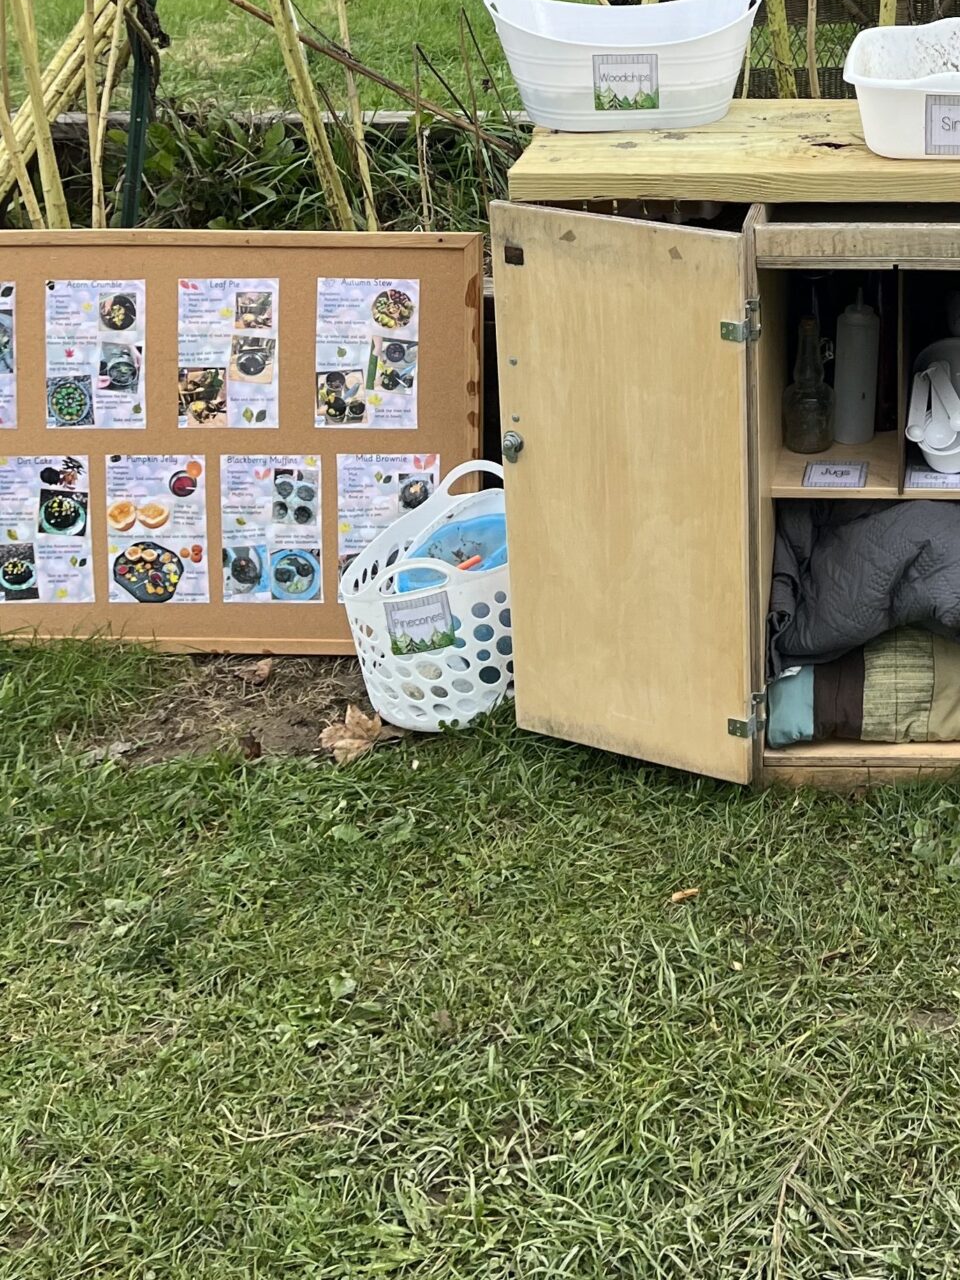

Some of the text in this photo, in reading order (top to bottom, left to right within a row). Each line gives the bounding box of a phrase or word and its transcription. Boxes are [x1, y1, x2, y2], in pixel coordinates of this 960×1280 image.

[600, 72, 651, 85] Woodchips
[209, 280, 240, 290] Leaf Pie
[341, 279, 393, 287] Autumn Stew
[17, 457, 53, 465] Dirt Cake
[126, 456, 178, 465] Pumpkin Jelly
[227, 456, 298, 466] Blackberry Muffins
[355, 455, 408, 463] Mud Brownie
[821, 467, 850, 478] Jugs
[393, 613, 444, 628] Pinecones
